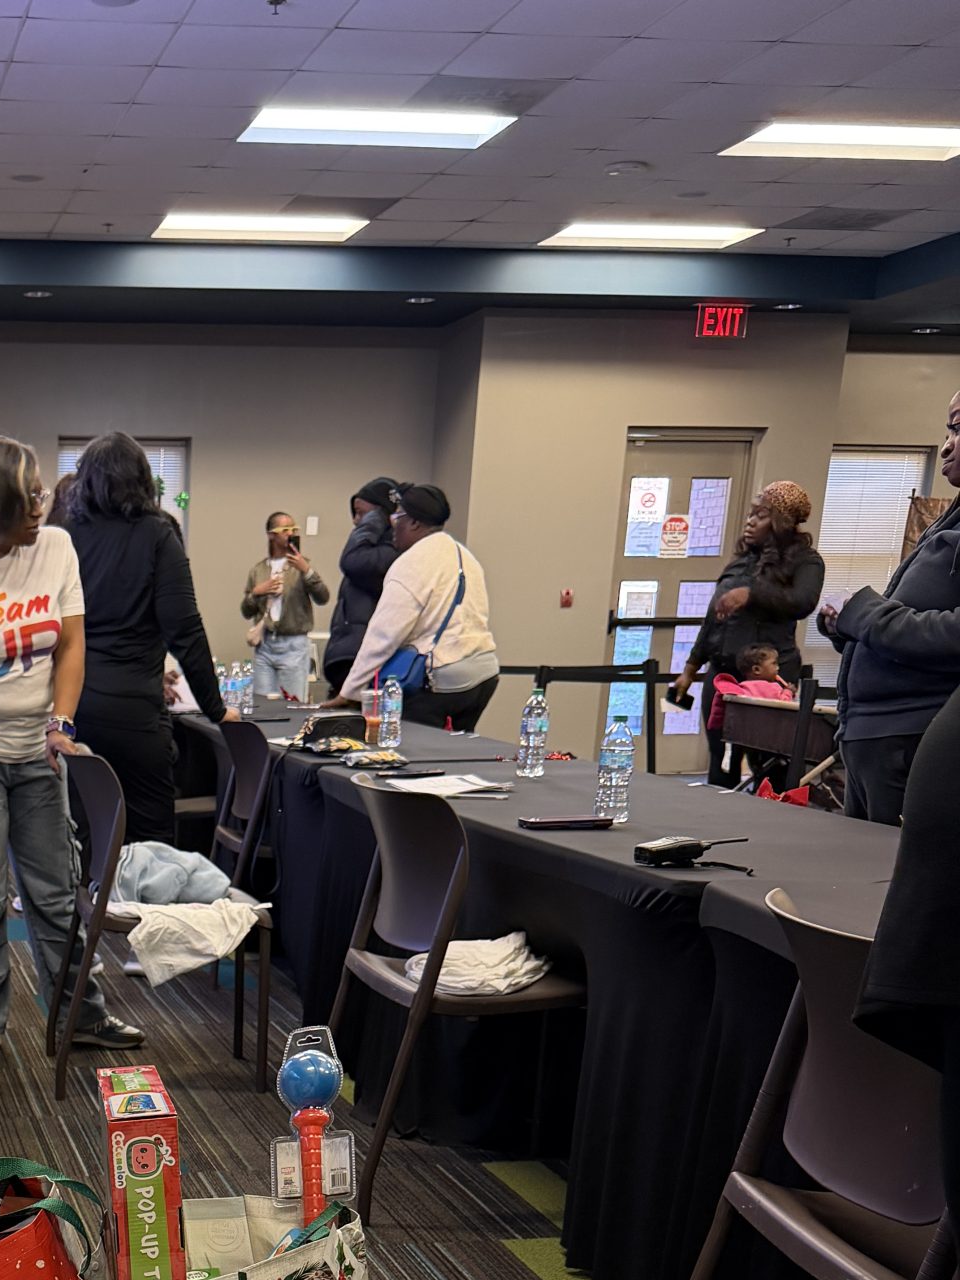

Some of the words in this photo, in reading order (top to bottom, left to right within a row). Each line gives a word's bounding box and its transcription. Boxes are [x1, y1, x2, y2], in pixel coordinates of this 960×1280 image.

[702, 307, 744, 337] EXIT
[665, 521, 687, 531] STOP
[134, 1185, 160, 1260] POP-UP
